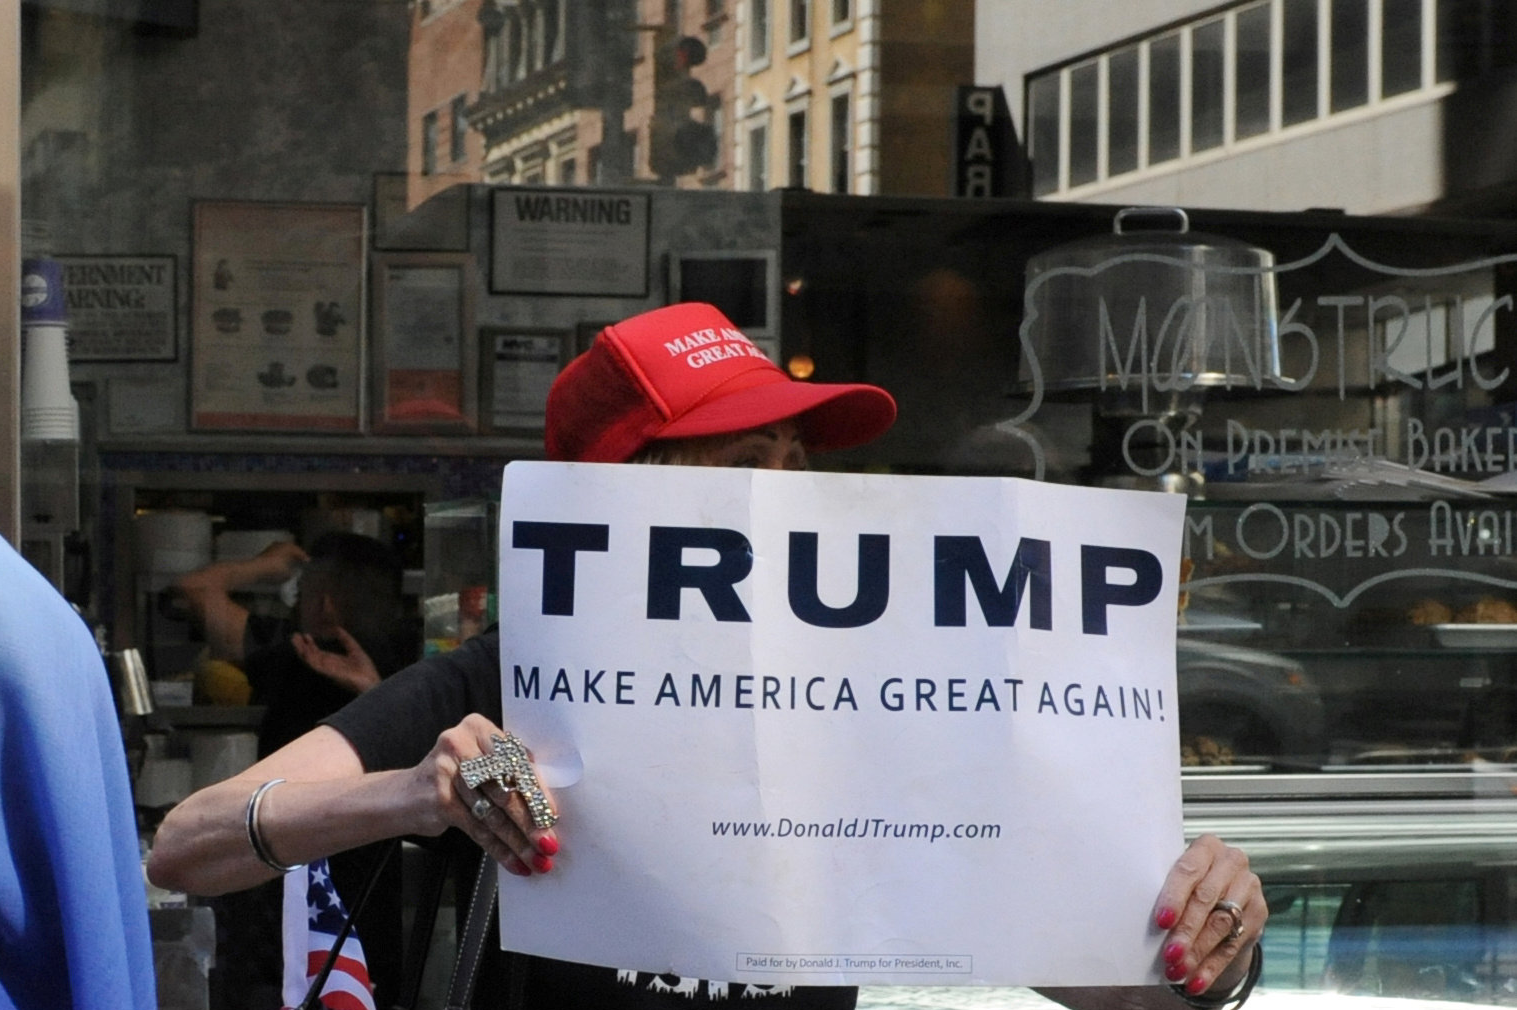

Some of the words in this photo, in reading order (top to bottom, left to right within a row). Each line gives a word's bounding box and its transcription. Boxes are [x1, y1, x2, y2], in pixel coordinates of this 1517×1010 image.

[514, 195, 632, 226] WARNING
[62, 263, 166, 286] ERNMENT
[663, 328, 722, 357] MAKE
[686, 342, 746, 369] GREAT
[512, 519, 1163, 636] TRUMP
[513, 664, 636, 706] MAKE
[654, 672, 859, 711] AMERICA
[880, 677, 1024, 712] GREAT
[1037, 681, 1166, 722] AGAIN!
[711, 817, 1002, 843] www.DonaldJTrump.com
[746, 956, 767, 968] Paid
[769, 956, 783, 968] for
[785, 957, 798, 970] by
[799, 957, 833, 969] Donald
[834, 958, 842, 969] J.
[845, 957, 876, 971] Trump
[878, 957, 892, 969] for
[894, 958, 944, 971] President,
[946, 958, 964, 969] Inc.
